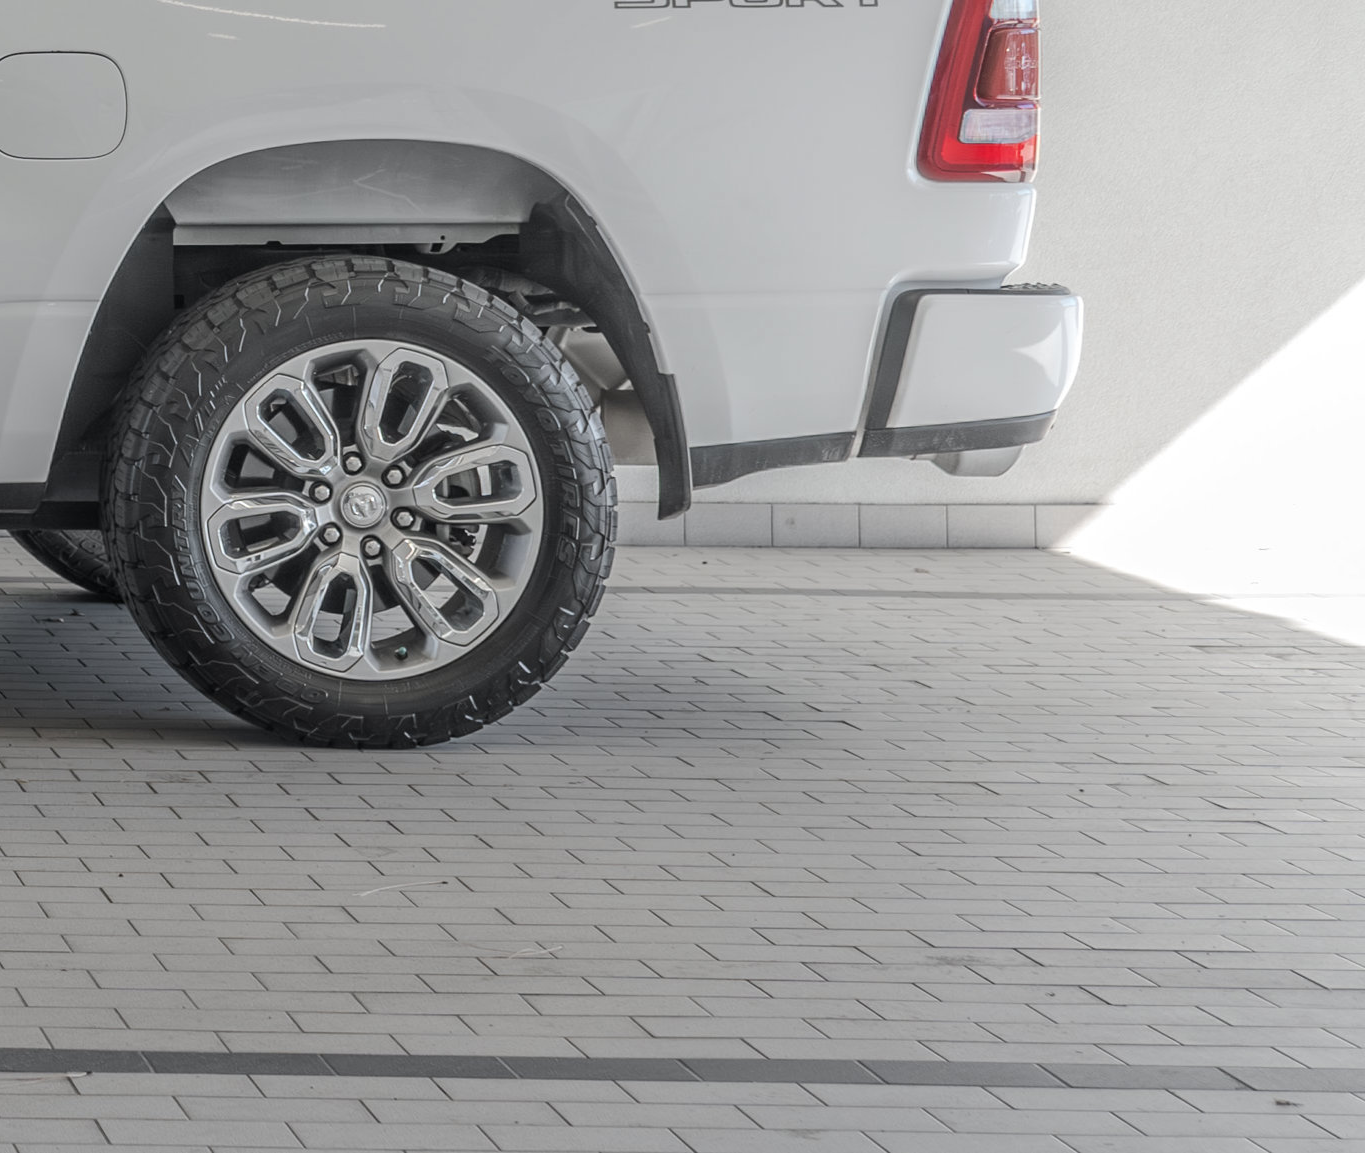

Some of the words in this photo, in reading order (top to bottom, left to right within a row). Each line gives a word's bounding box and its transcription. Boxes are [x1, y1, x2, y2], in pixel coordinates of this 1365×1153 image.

[485, 342, 562, 432] TOYO
[549, 439, 581, 568] TIRES
[171, 473, 234, 644] COUNTRY
